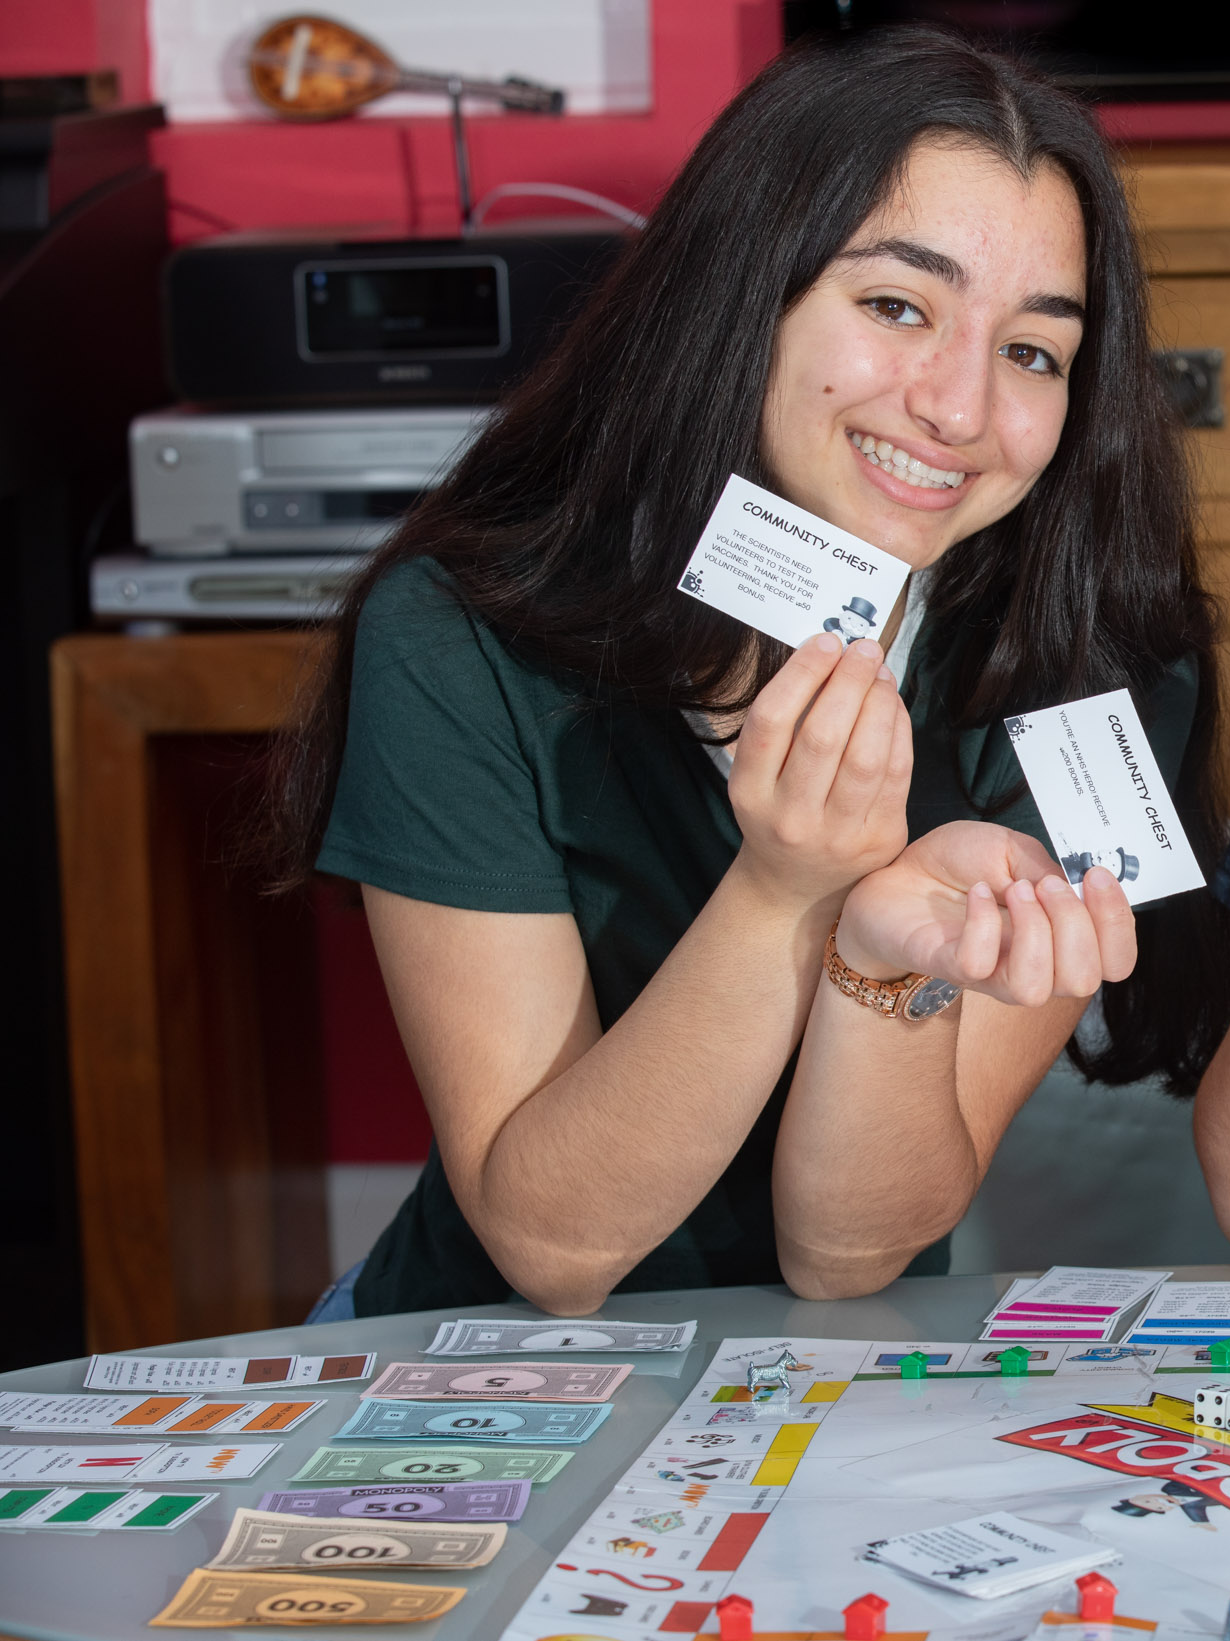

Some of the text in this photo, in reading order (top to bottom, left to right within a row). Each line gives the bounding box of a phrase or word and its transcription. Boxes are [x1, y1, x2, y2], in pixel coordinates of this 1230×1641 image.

[742, 501, 879, 576] COMMUNITY CHEST
[715, 532, 820, 591] VOLUNTEERS TO TEST THEIR
[732, 528, 812, 574] THE SCIENTISTS NEED
[704, 551, 761, 588] VOLUNTEERING,
[762, 582, 796, 603] RECEIVE
[711, 542, 814, 600] VACCINES. THANK YOU FOR
[736, 583, 766, 603] BONUS.
[1058, 709, 1111, 827] YOU'RE AN NHS HERO! RECEIVE
[1067, 766, 1084, 797] BONUS.
[1107, 714, 1173, 851] COMMUNITY CHEST
[560, 1337, 576, 1348] 1
[481, 1377, 515, 1388] 5
[450, 1417, 500, 1429] 10
[205, 1448, 241, 1469] NOW
[402, 1462, 469, 1474] 20
[355, 1486, 442, 1496] MONOPOLY
[679, 1483, 711, 1504] NOW
[362, 1502, 424, 1514] 50
[313, 1545, 400, 1559] 100
[268, 1598, 356, 1614] 500
